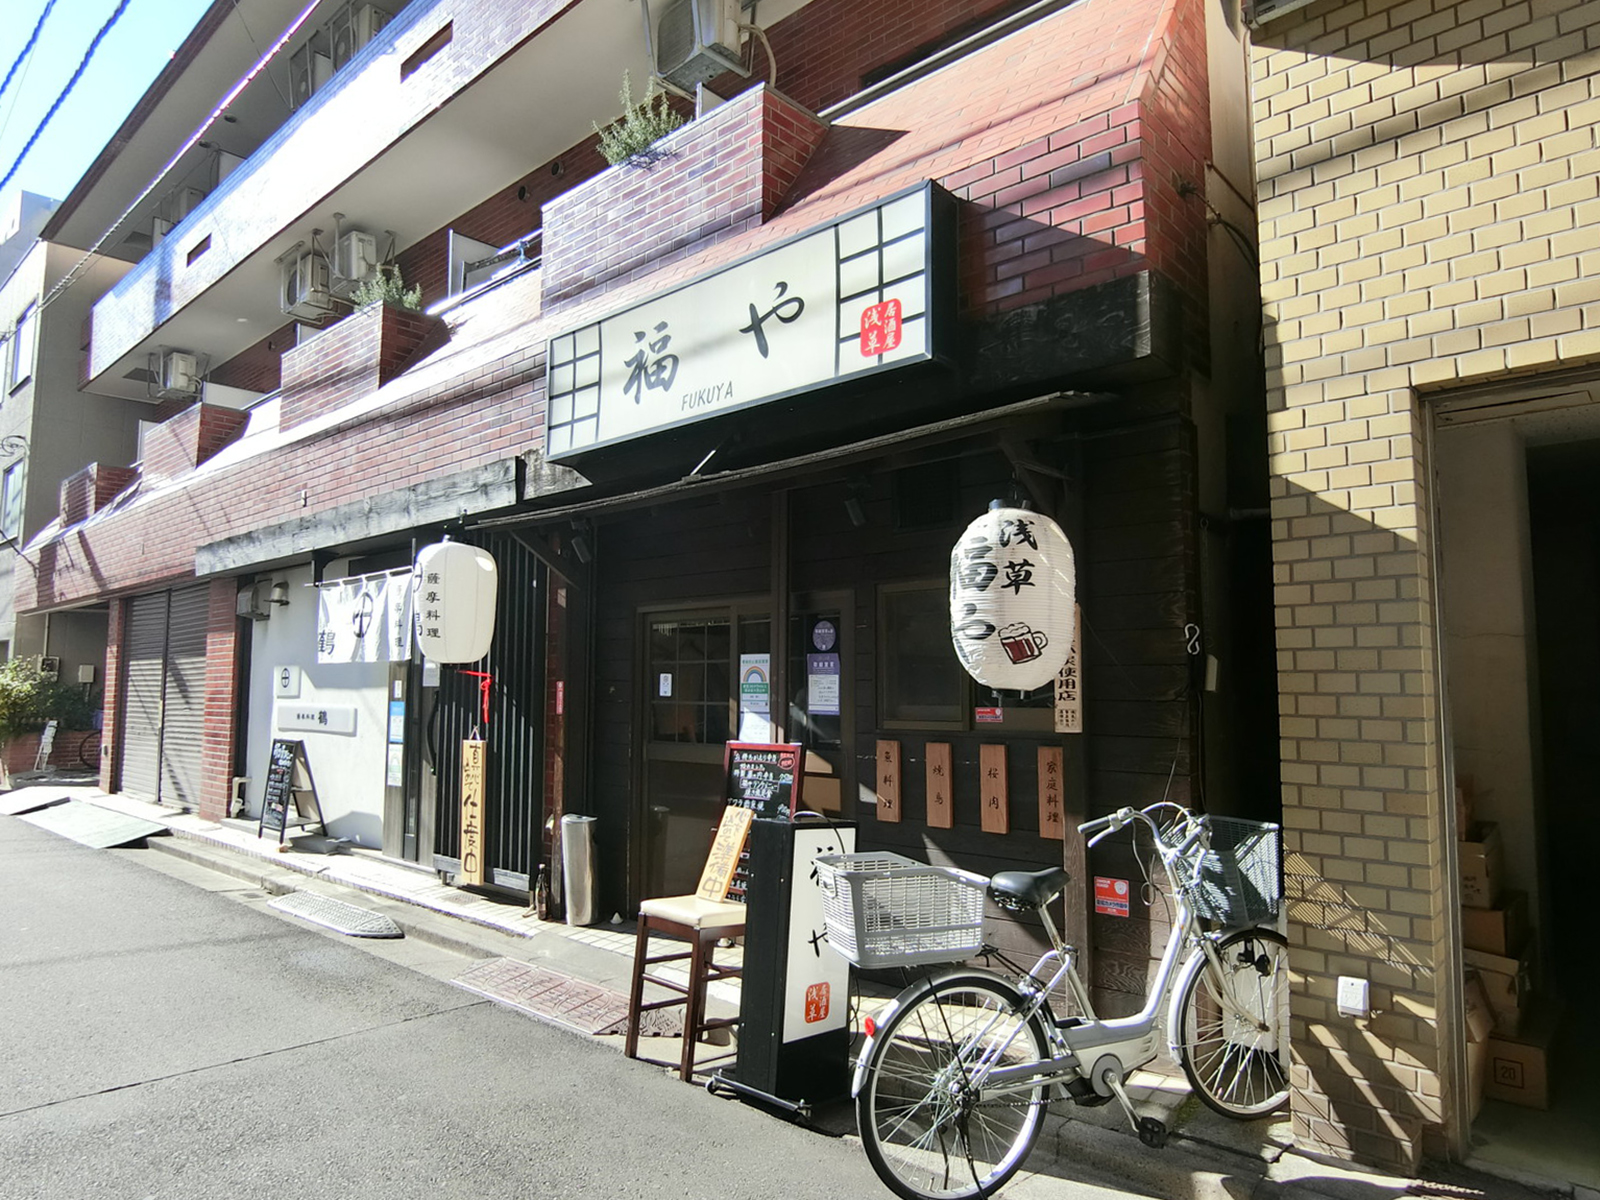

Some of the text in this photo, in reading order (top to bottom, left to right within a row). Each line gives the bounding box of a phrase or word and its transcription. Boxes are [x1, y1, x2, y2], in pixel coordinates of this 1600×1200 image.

[623, 281, 805, 405] 福や
[864, 307, 882, 353] 浅草
[883, 301, 897, 349] 居酒屋
[681, 380, 734, 411] FUKUYA
[1000, 519, 1038, 595] 浅草
[425, 572, 441, 639] 薩摩料理
[883, 751, 893, 810] 魚料理
[987, 767, 999, 810] 桜肉
[1045, 760, 1059, 824] 家庭料理
[807, 986, 819, 1021] 浅草
[819, 984, 830, 1018] 居酒屋
[1501, 1065, 1516, 1081] 20
